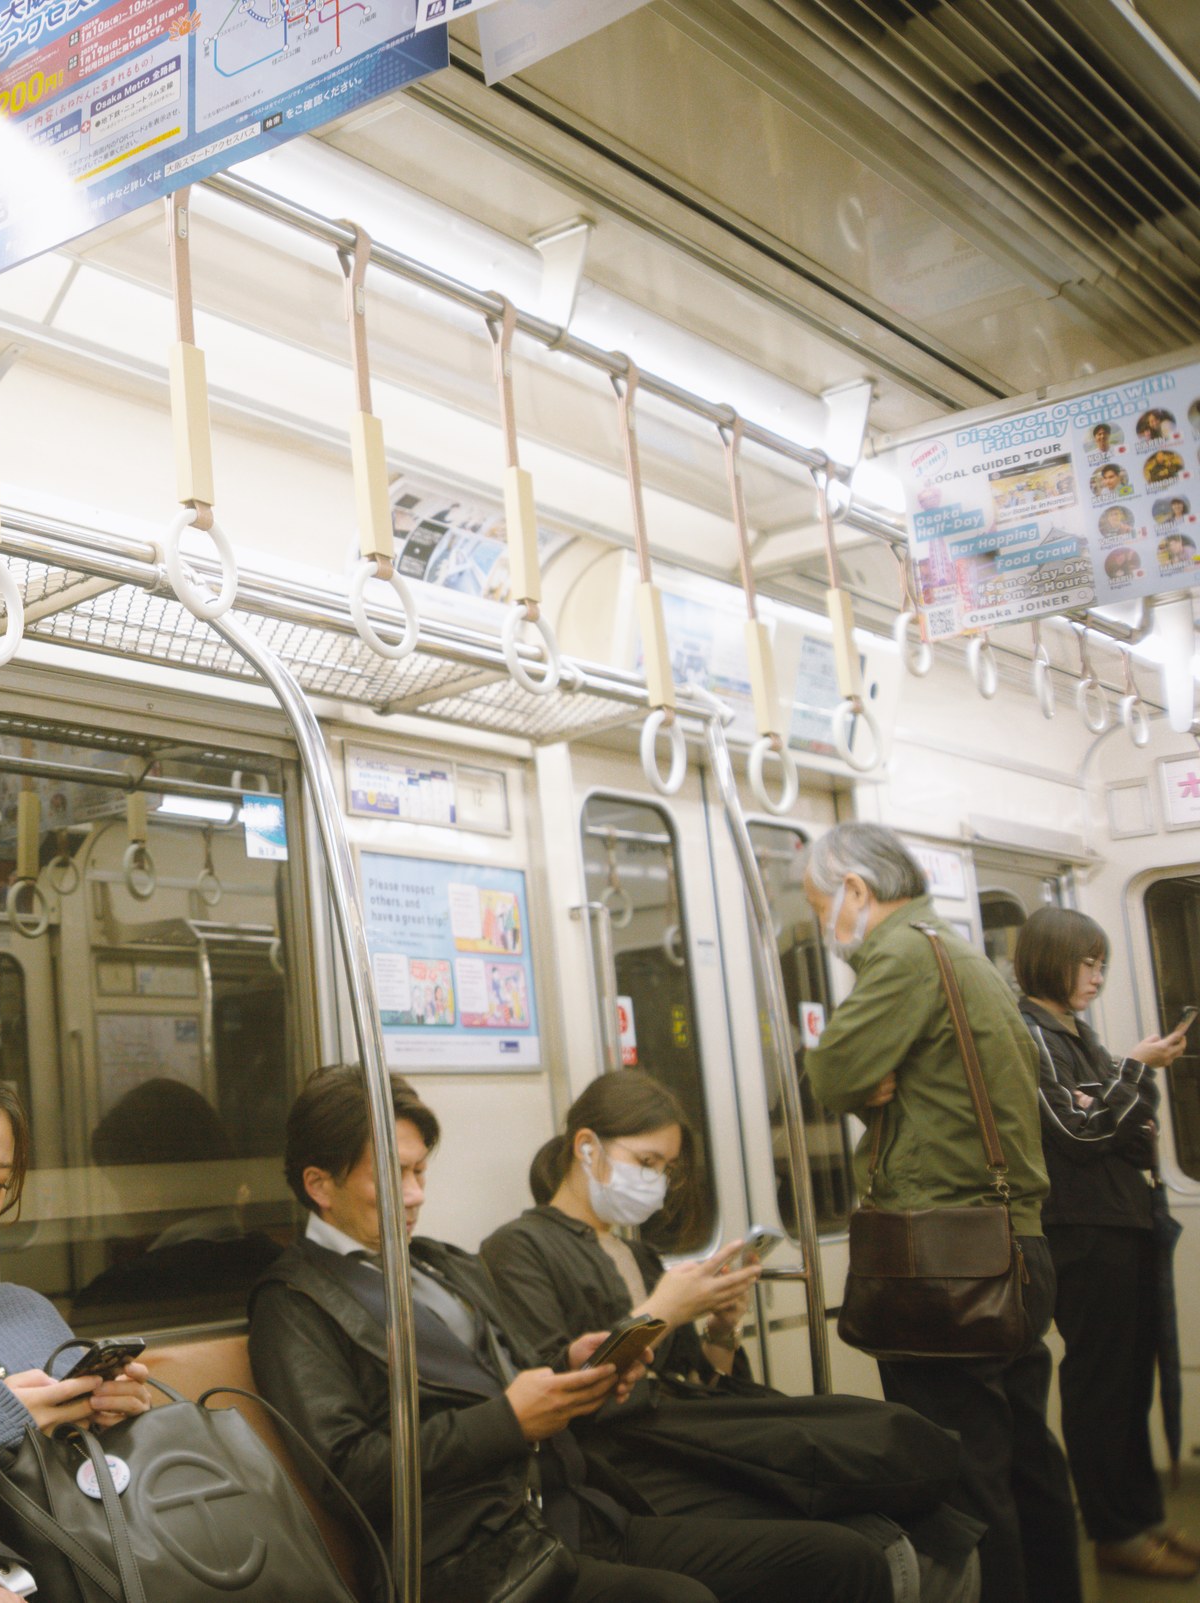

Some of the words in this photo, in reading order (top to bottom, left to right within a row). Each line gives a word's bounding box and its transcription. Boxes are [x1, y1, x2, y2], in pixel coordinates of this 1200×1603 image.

[94, 88, 122, 112] Osaka
[124, 77, 150, 98] Metro
[152, 62, 178, 84] 全路線
[285, 78, 363, 119] をご確認ください。
[956, 412, 1048, 447] Discover
[1050, 391, 1120, 421] Osaka
[1123, 373, 1176, 399] with
[982, 420, 1070, 455] Friendly
[1073, 400, 1150, 429] Guides
[972, 455, 1021, 475] GUIDED
[1024, 442, 1062, 461] TOUR
[915, 507, 961, 528] Osaka
[917, 514, 982, 539] Half-Day
[951, 542, 975, 555] Bar
[978, 527, 1039, 549] Hopping
[996, 554, 1031, 569] Food
[1035, 541, 1078, 561] Crawl
[979, 587, 1026, 606] #From
[1030, 584, 1040, 596] 2
[1044, 574, 1090, 592] Hours
[969, 608, 1013, 624] Osaka
[1017, 594, 1071, 614] JOINER
[368, 877, 399, 892] Please
[401, 884, 435, 896] respect
[371, 909, 393, 923] have
